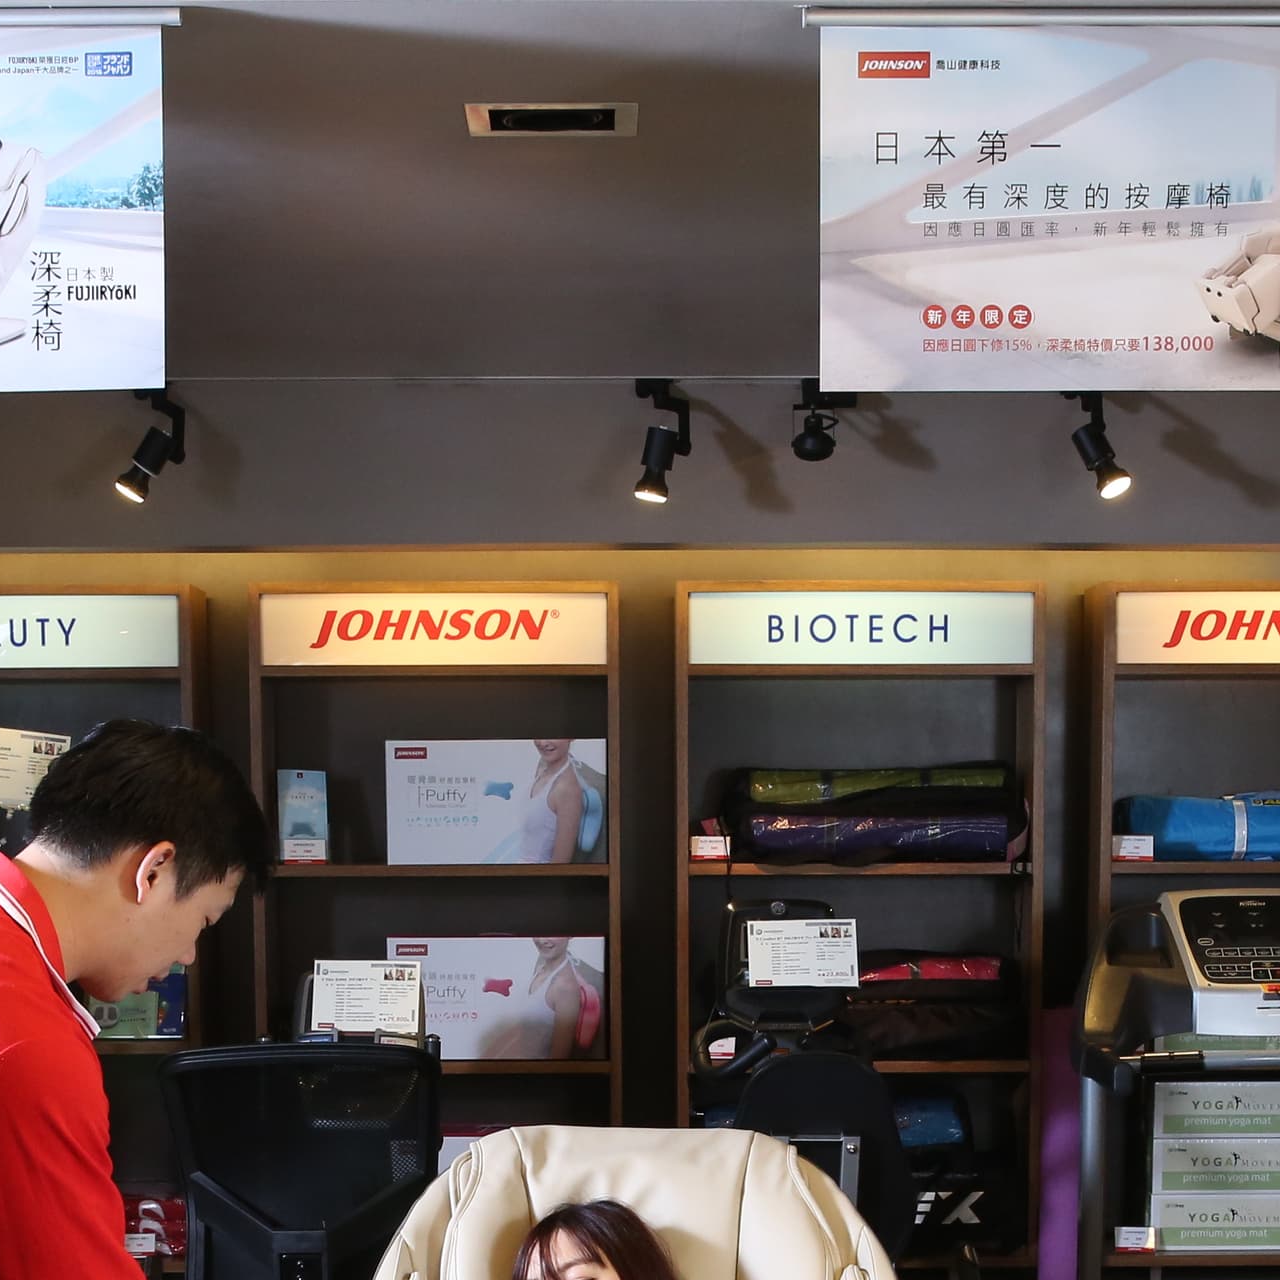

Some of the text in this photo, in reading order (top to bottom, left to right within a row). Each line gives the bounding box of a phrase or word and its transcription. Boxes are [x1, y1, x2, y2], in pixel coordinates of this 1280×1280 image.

[862, 60, 927, 71] JOHNSON
[936, 59, 1001, 71] 喬山健康科技
[875, 130, 1062, 165] 日本第一
[922, 182, 1232, 210] 最有深度的按摩椅
[66, 267, 114, 281] 日本製
[30, 251, 63, 351] 深柔椅
[925, 308, 1029, 326] 新年限定
[310, 608, 552, 649] JOHNSON
[767, 613, 950, 644] BIOTECH
[1192, 1099, 1234, 1111] YOGA
[1183, 1116, 1272, 1127] premium yoga mat
[1190, 1156, 1233, 1167] YOGA
[1182, 1173, 1270, 1184] premium yoga mat
[1188, 1212, 1231, 1223] YOGA
[1180, 1228, 1268, 1240] premium yoga mat
